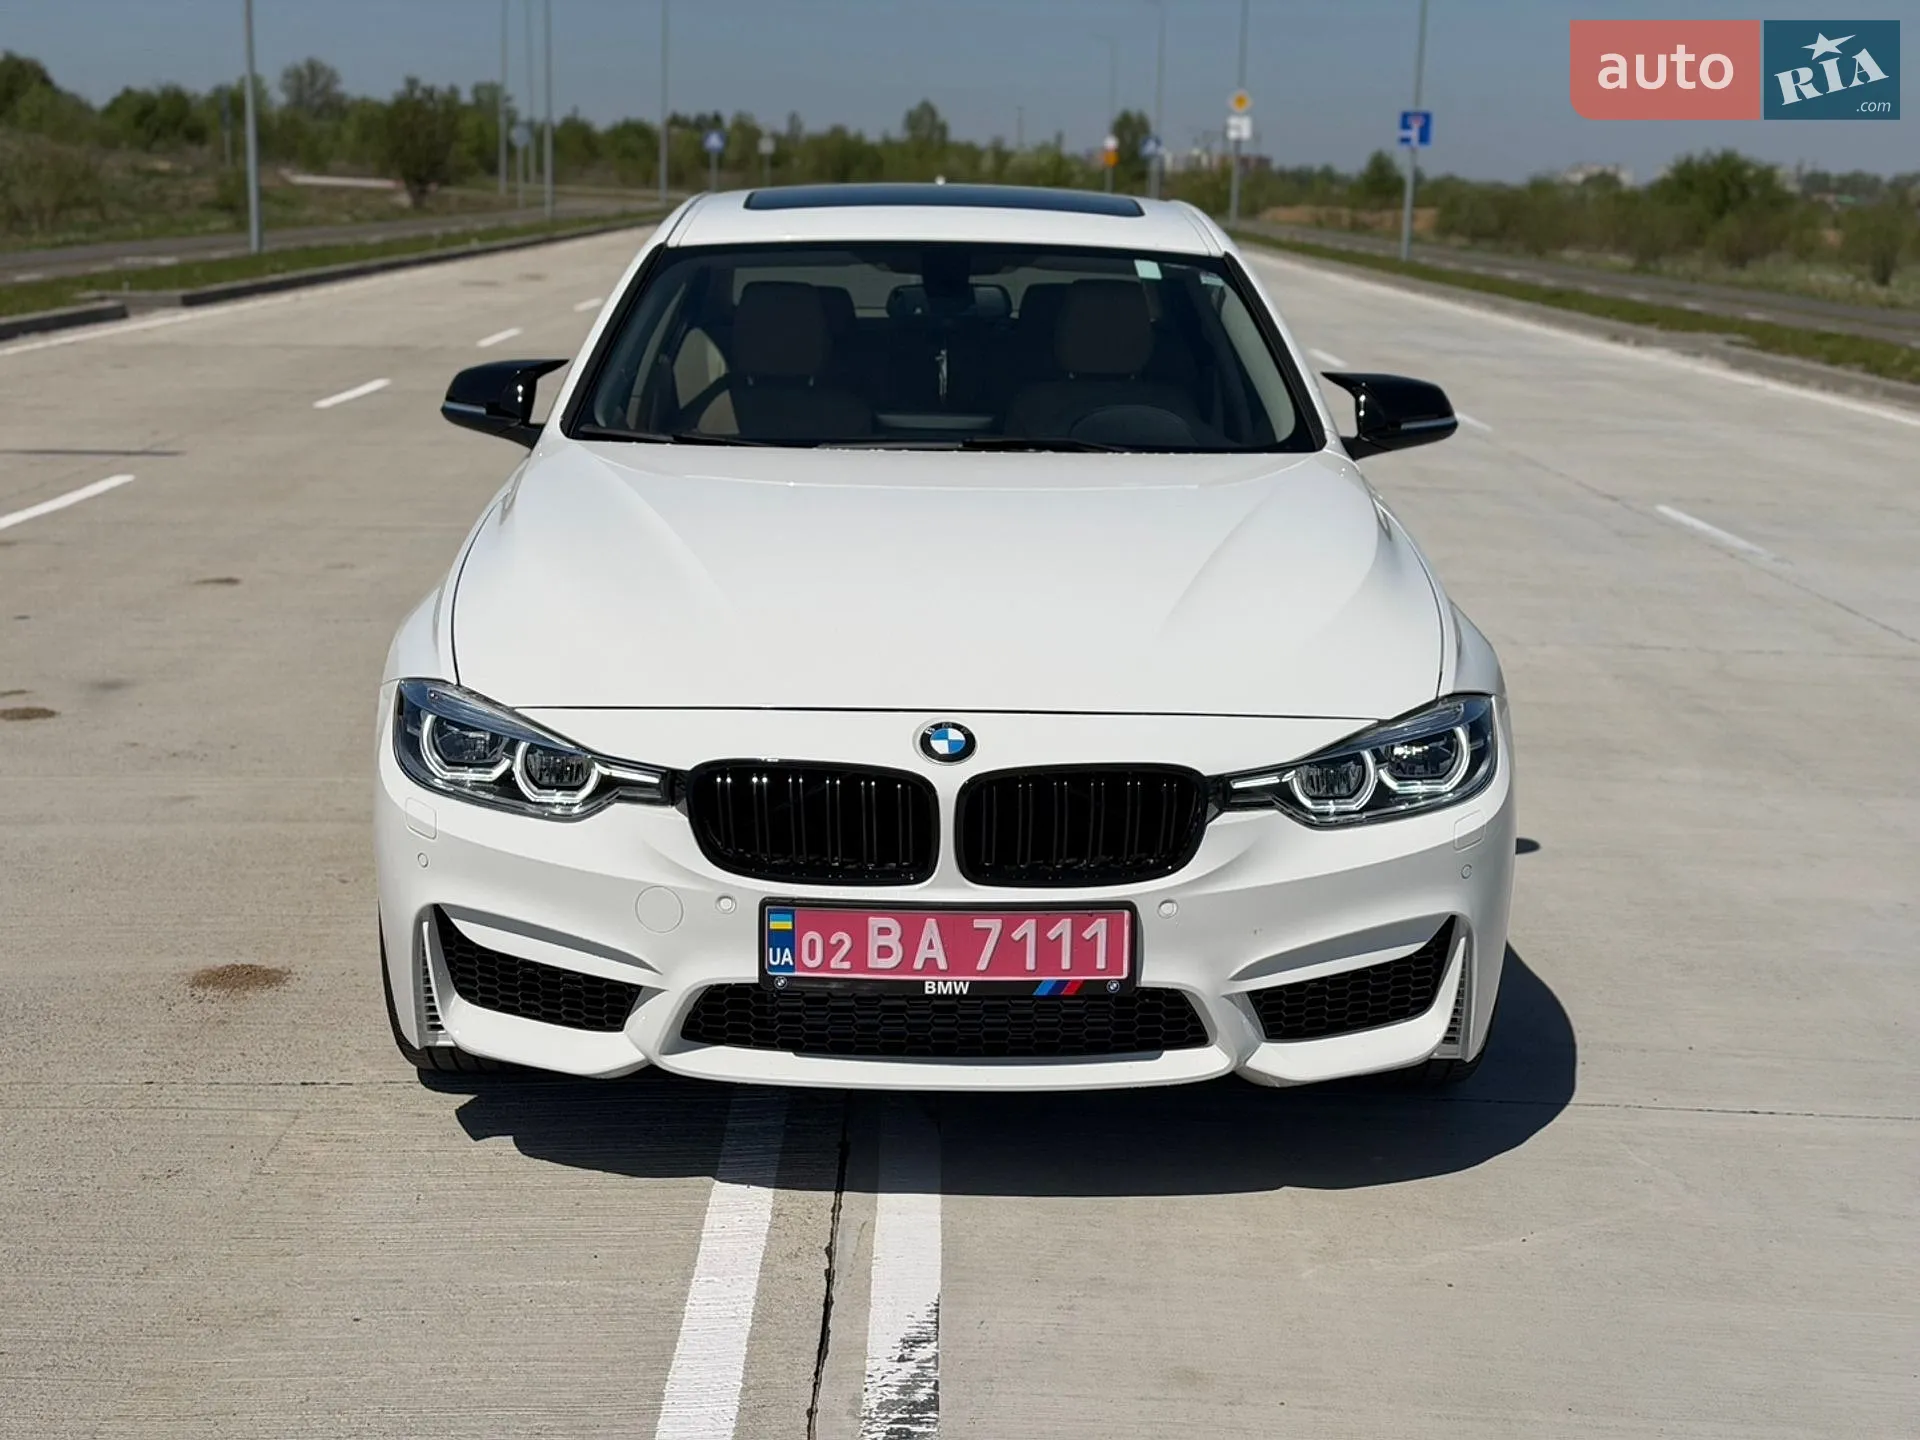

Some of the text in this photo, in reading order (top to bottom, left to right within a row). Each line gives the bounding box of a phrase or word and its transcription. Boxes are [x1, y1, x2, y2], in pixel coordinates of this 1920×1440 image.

[801, 916, 1107, 971] 02 BA 7111
[769, 948, 793, 966] UA
[924, 981, 969, 995] BMW
